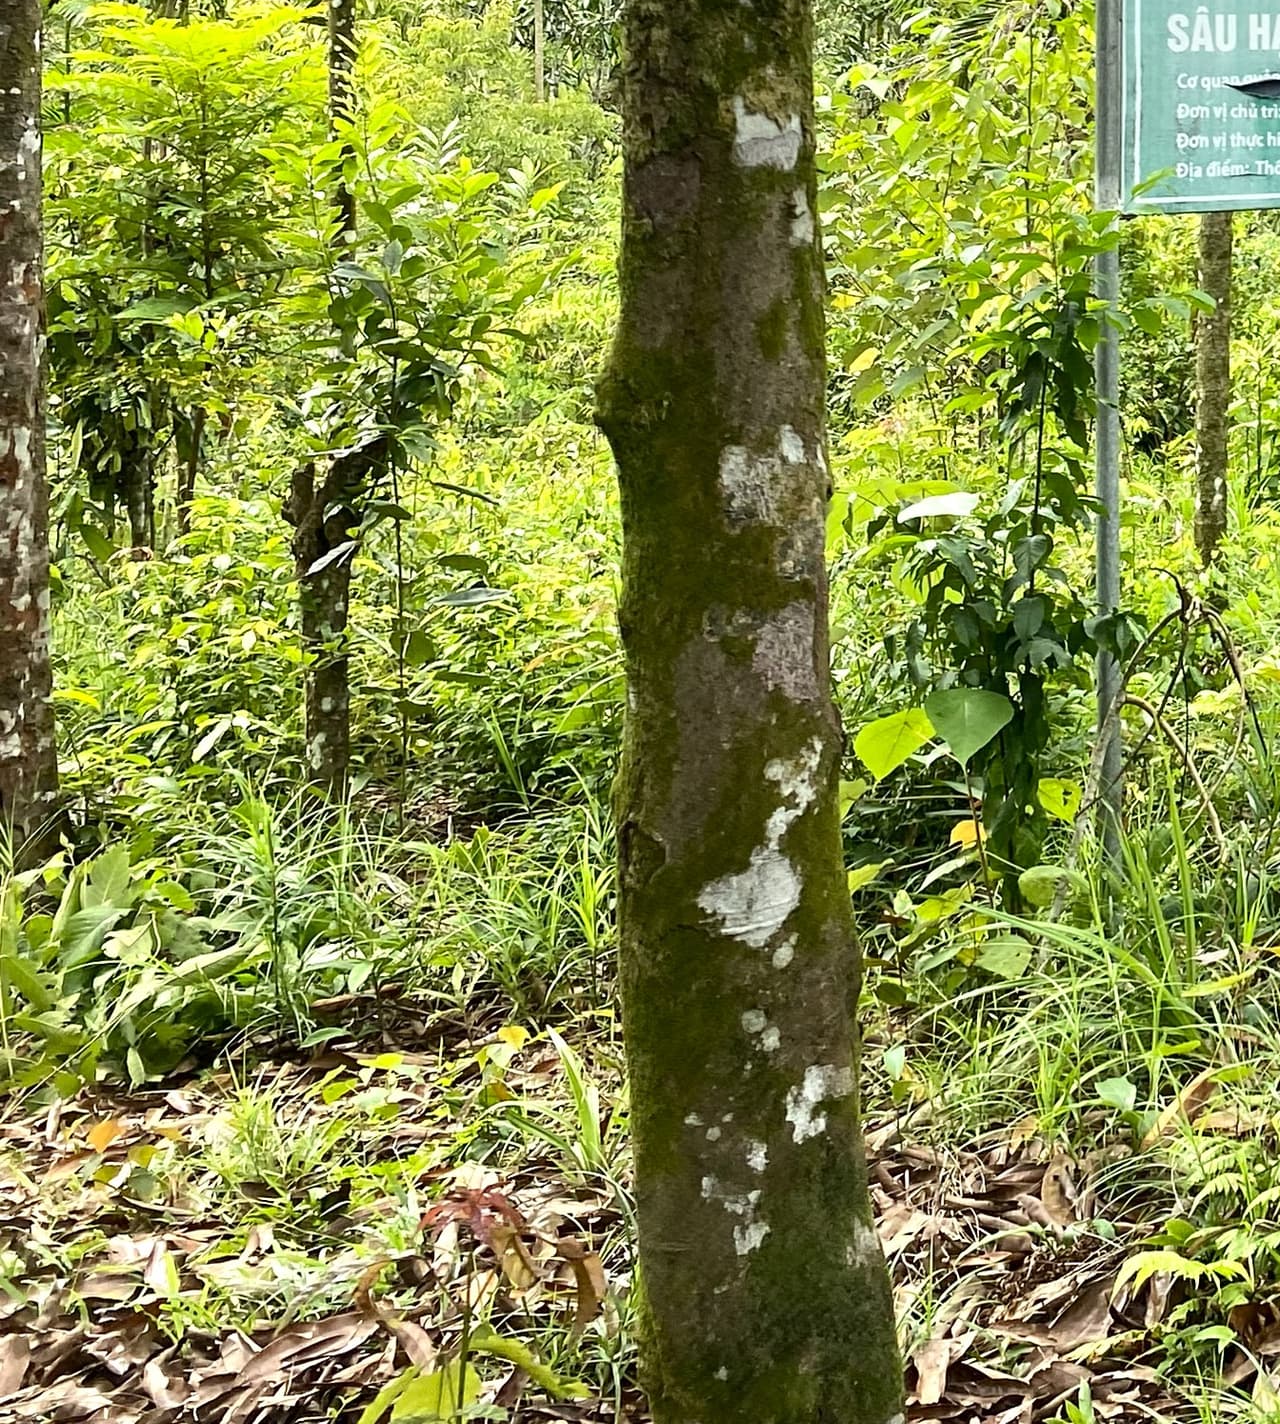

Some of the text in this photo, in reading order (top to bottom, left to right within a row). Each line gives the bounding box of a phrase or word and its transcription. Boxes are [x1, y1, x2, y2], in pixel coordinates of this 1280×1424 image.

[1167, 6, 1236, 53] SÂU
[1177, 73, 1199, 89] Cơ
[1176, 103, 1210, 119] Đơn
[1213, 102, 1227, 122] vị
[1231, 102, 1258, 119] chủ
[1176, 133, 1209, 148] Đơn
[1213, 132, 1227, 151] vị
[1230, 133, 1264, 151] thực
[1176, 162, 1202, 182] Địa
